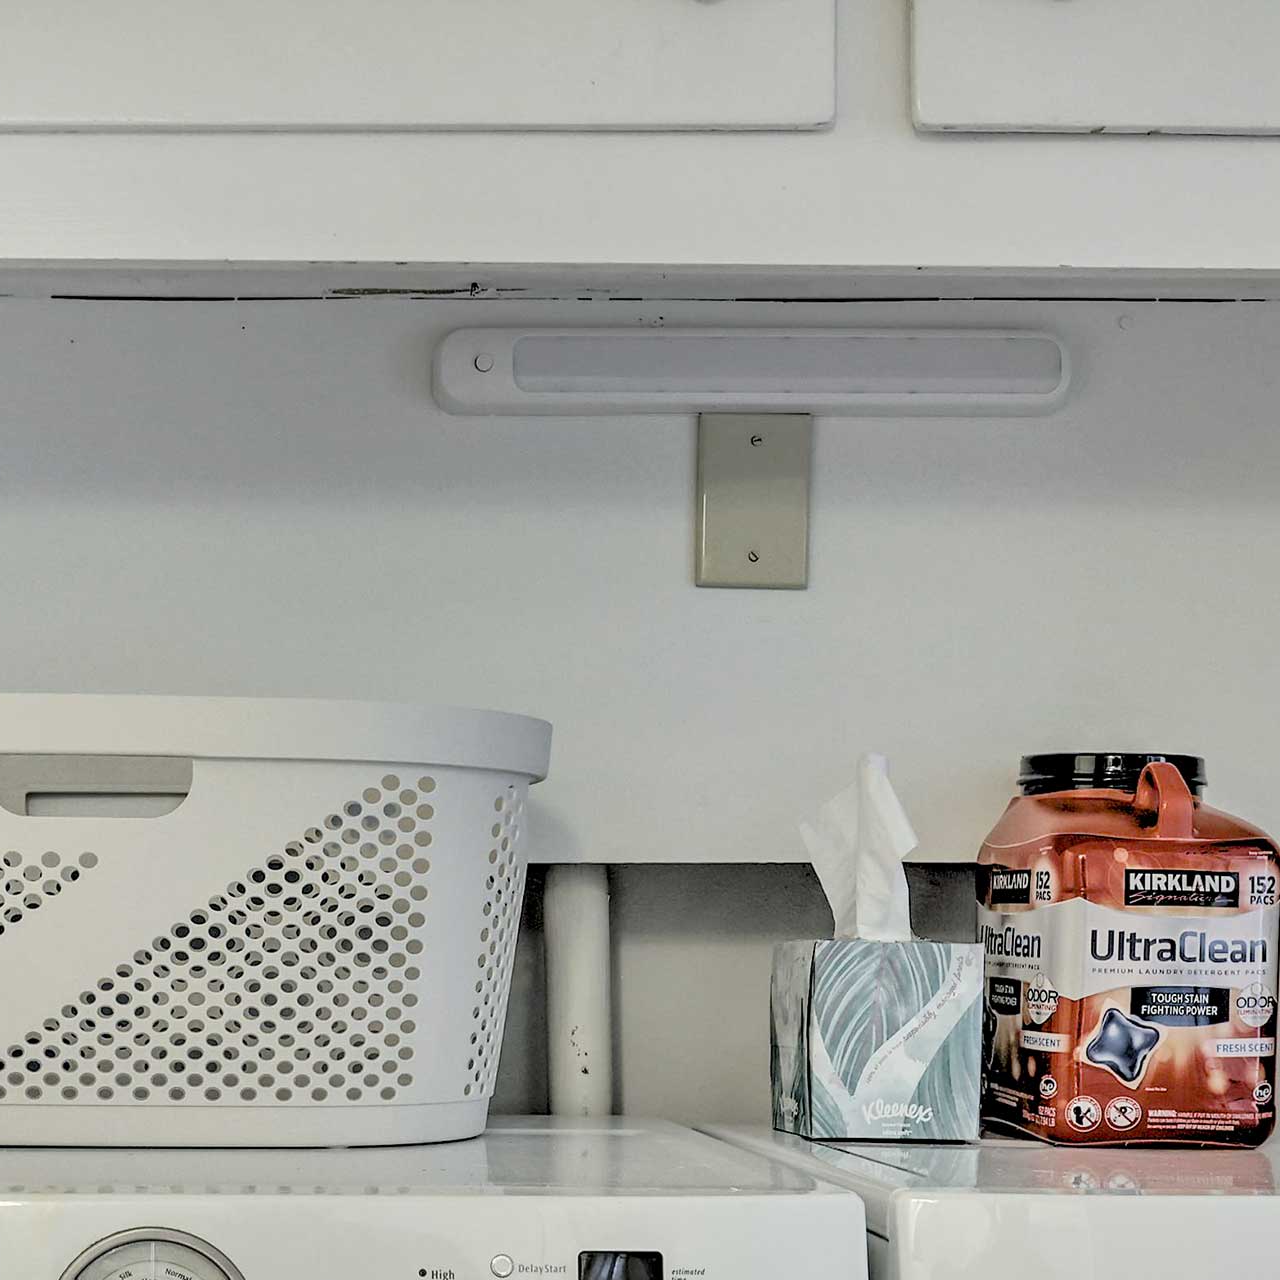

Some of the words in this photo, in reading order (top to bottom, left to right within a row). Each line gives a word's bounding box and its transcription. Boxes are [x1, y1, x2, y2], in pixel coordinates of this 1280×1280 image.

[993, 873, 1029, 889] KIRKLAND
[1036, 871, 1050, 889] 152
[1129, 873, 1236, 893] KIRKLAND
[1249, 876, 1275, 894] 152
[1036, 891, 1051, 901] PACS
[1129, 891, 1234, 906] Signature
[1250, 896, 1274, 905] PACS
[1090, 930, 1267, 963] UltraClean
[1139, 968, 1184, 976] LAUNDRY
[1027, 988, 1058, 1003] ODOR
[1151, 993, 1183, 1004] TOUGH
[1184, 993, 1209, 1004] STAIN
[1236, 996, 1275, 1009] ODOR
[1141, 1005, 1184, 1016] FIGHTING
[1186, 1005, 1218, 1016] POWER
[1023, 1034, 1038, 1046] FRESH
[1038, 1036, 1061, 1048] SCENT
[1216, 1043, 1247, 1053] FRESH
[1249, 1043, 1275, 1053] SCENT
[862, 1098, 934, 1124] Kleenex
[119, 1270, 133, 1280] Silk
[671, 1268, 706, 1276] estimated
